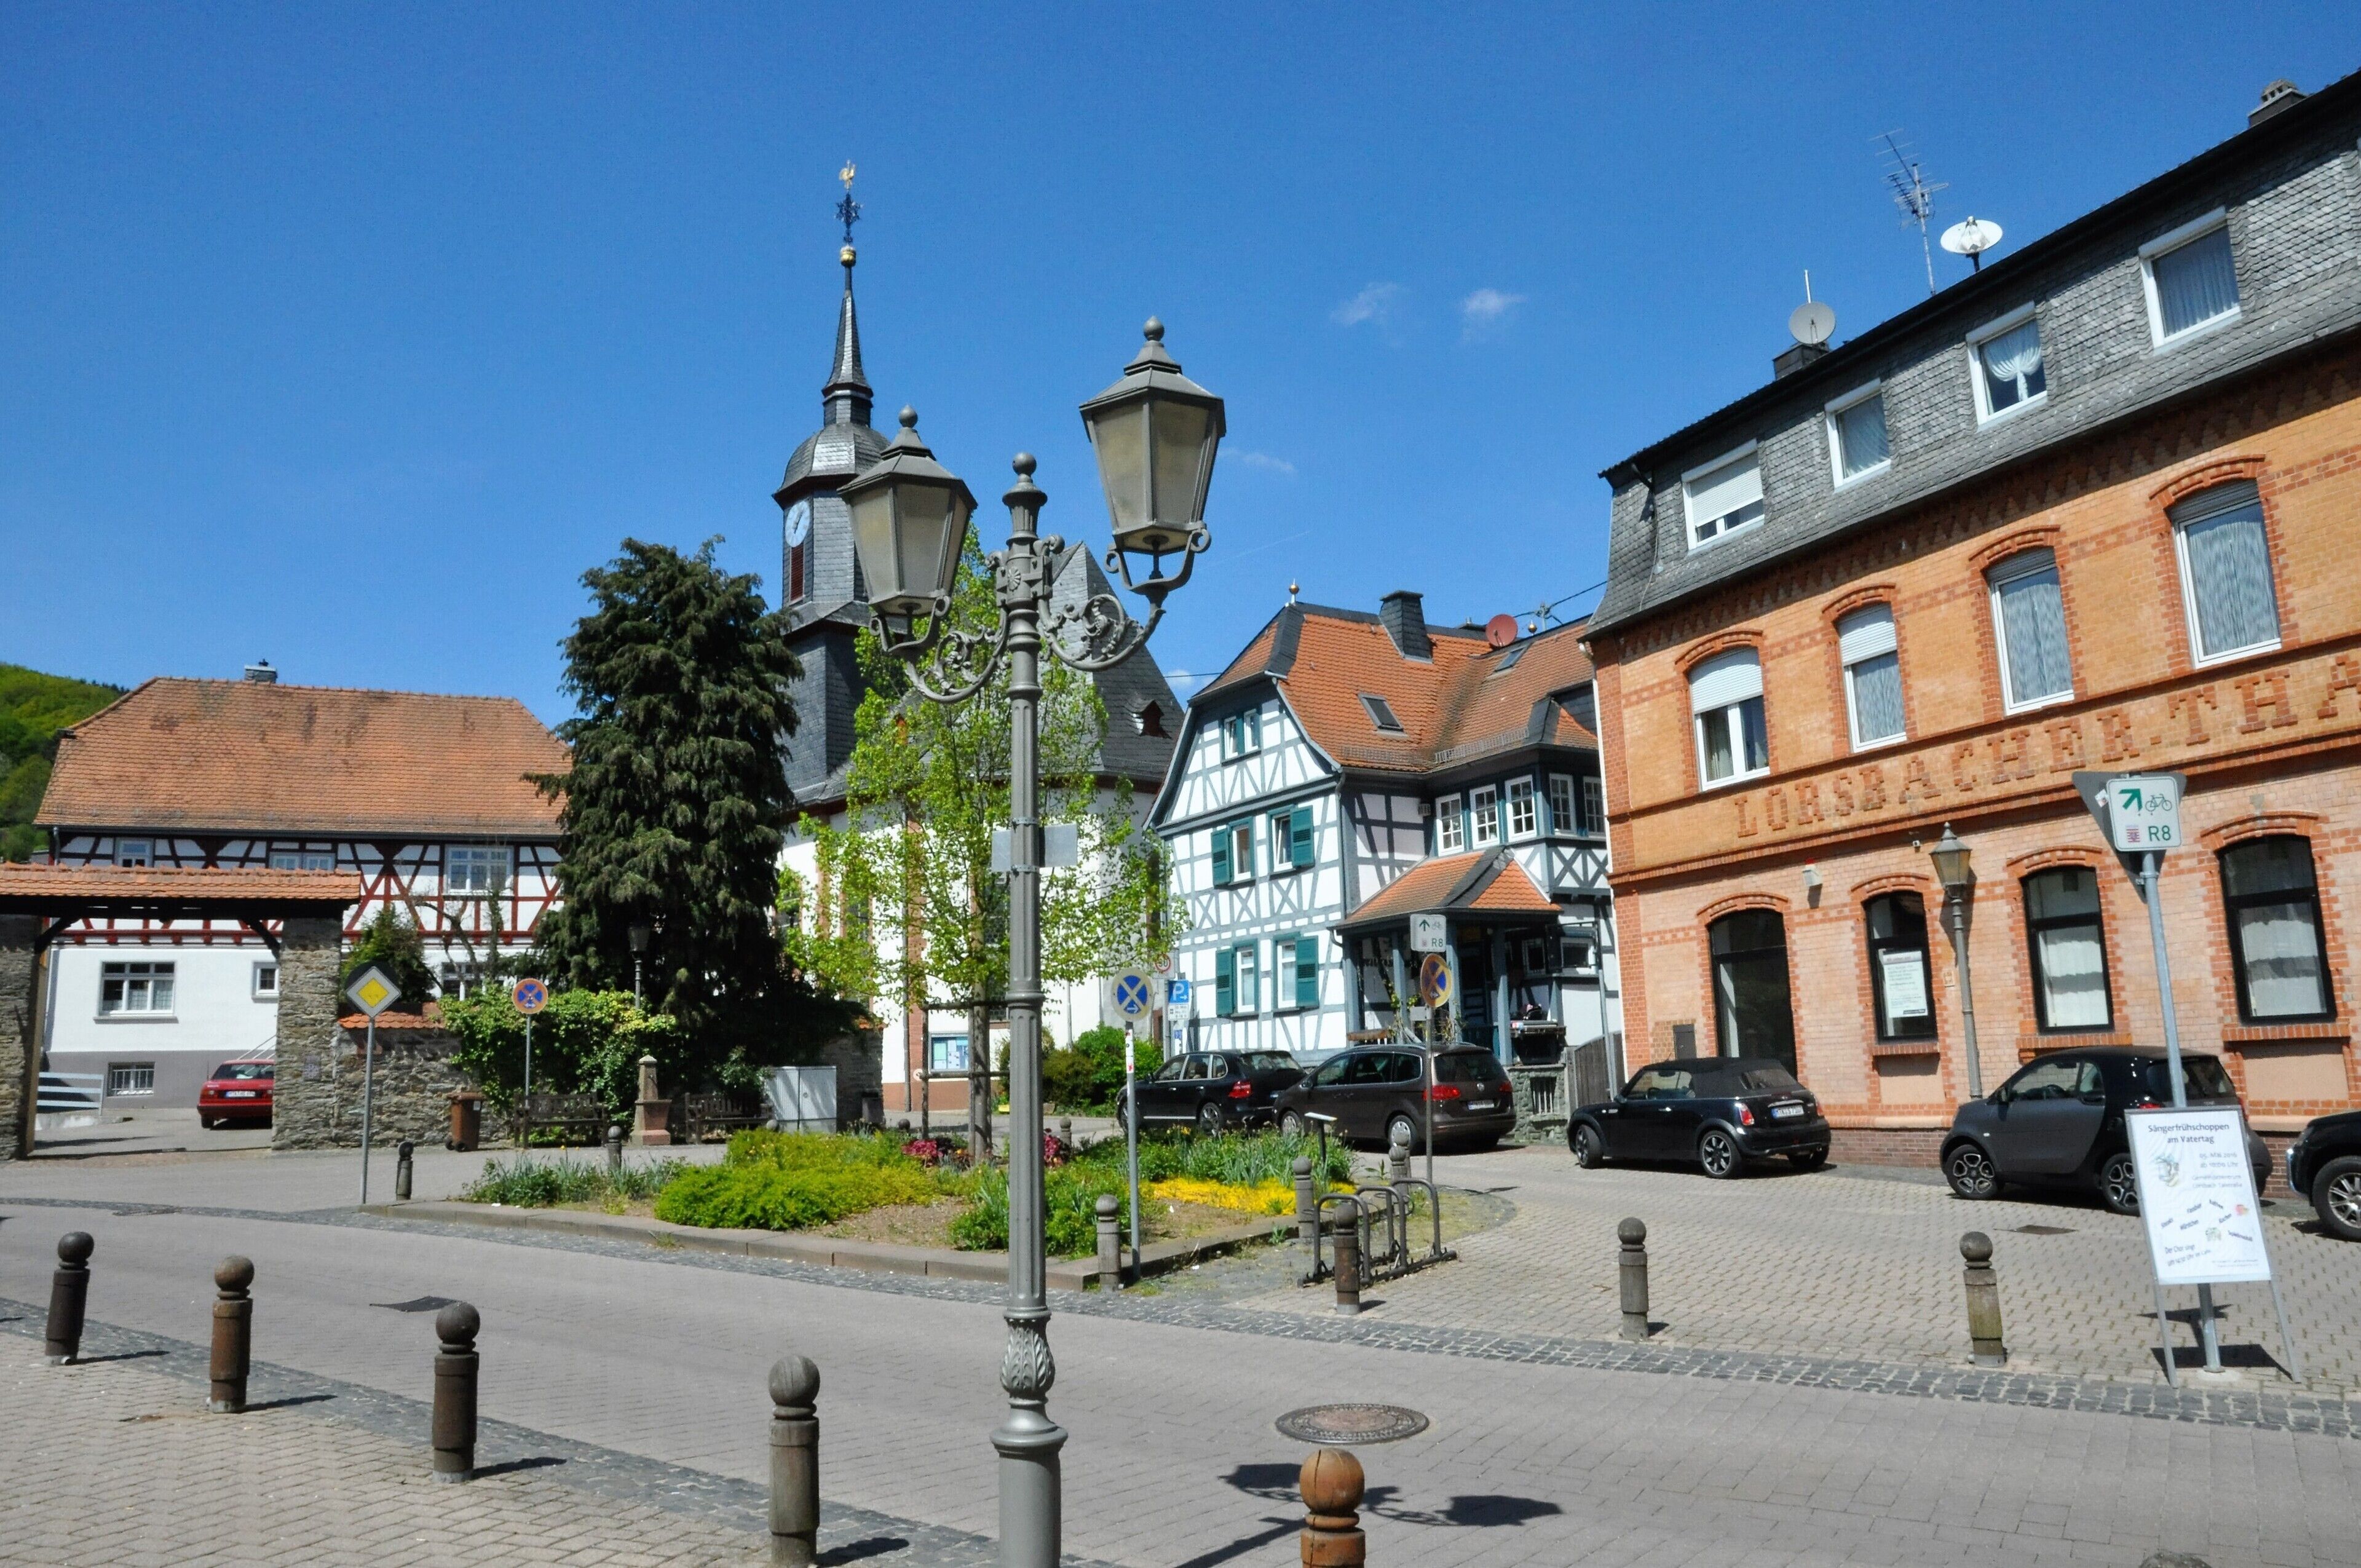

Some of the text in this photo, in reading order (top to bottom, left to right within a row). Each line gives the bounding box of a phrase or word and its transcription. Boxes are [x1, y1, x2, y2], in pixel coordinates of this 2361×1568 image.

[2148, 825, 2171, 841] R8
[1431, 938, 1443, 947] R8
[2148, 1123, 2229, 1134] Sängerfrühschoppen
